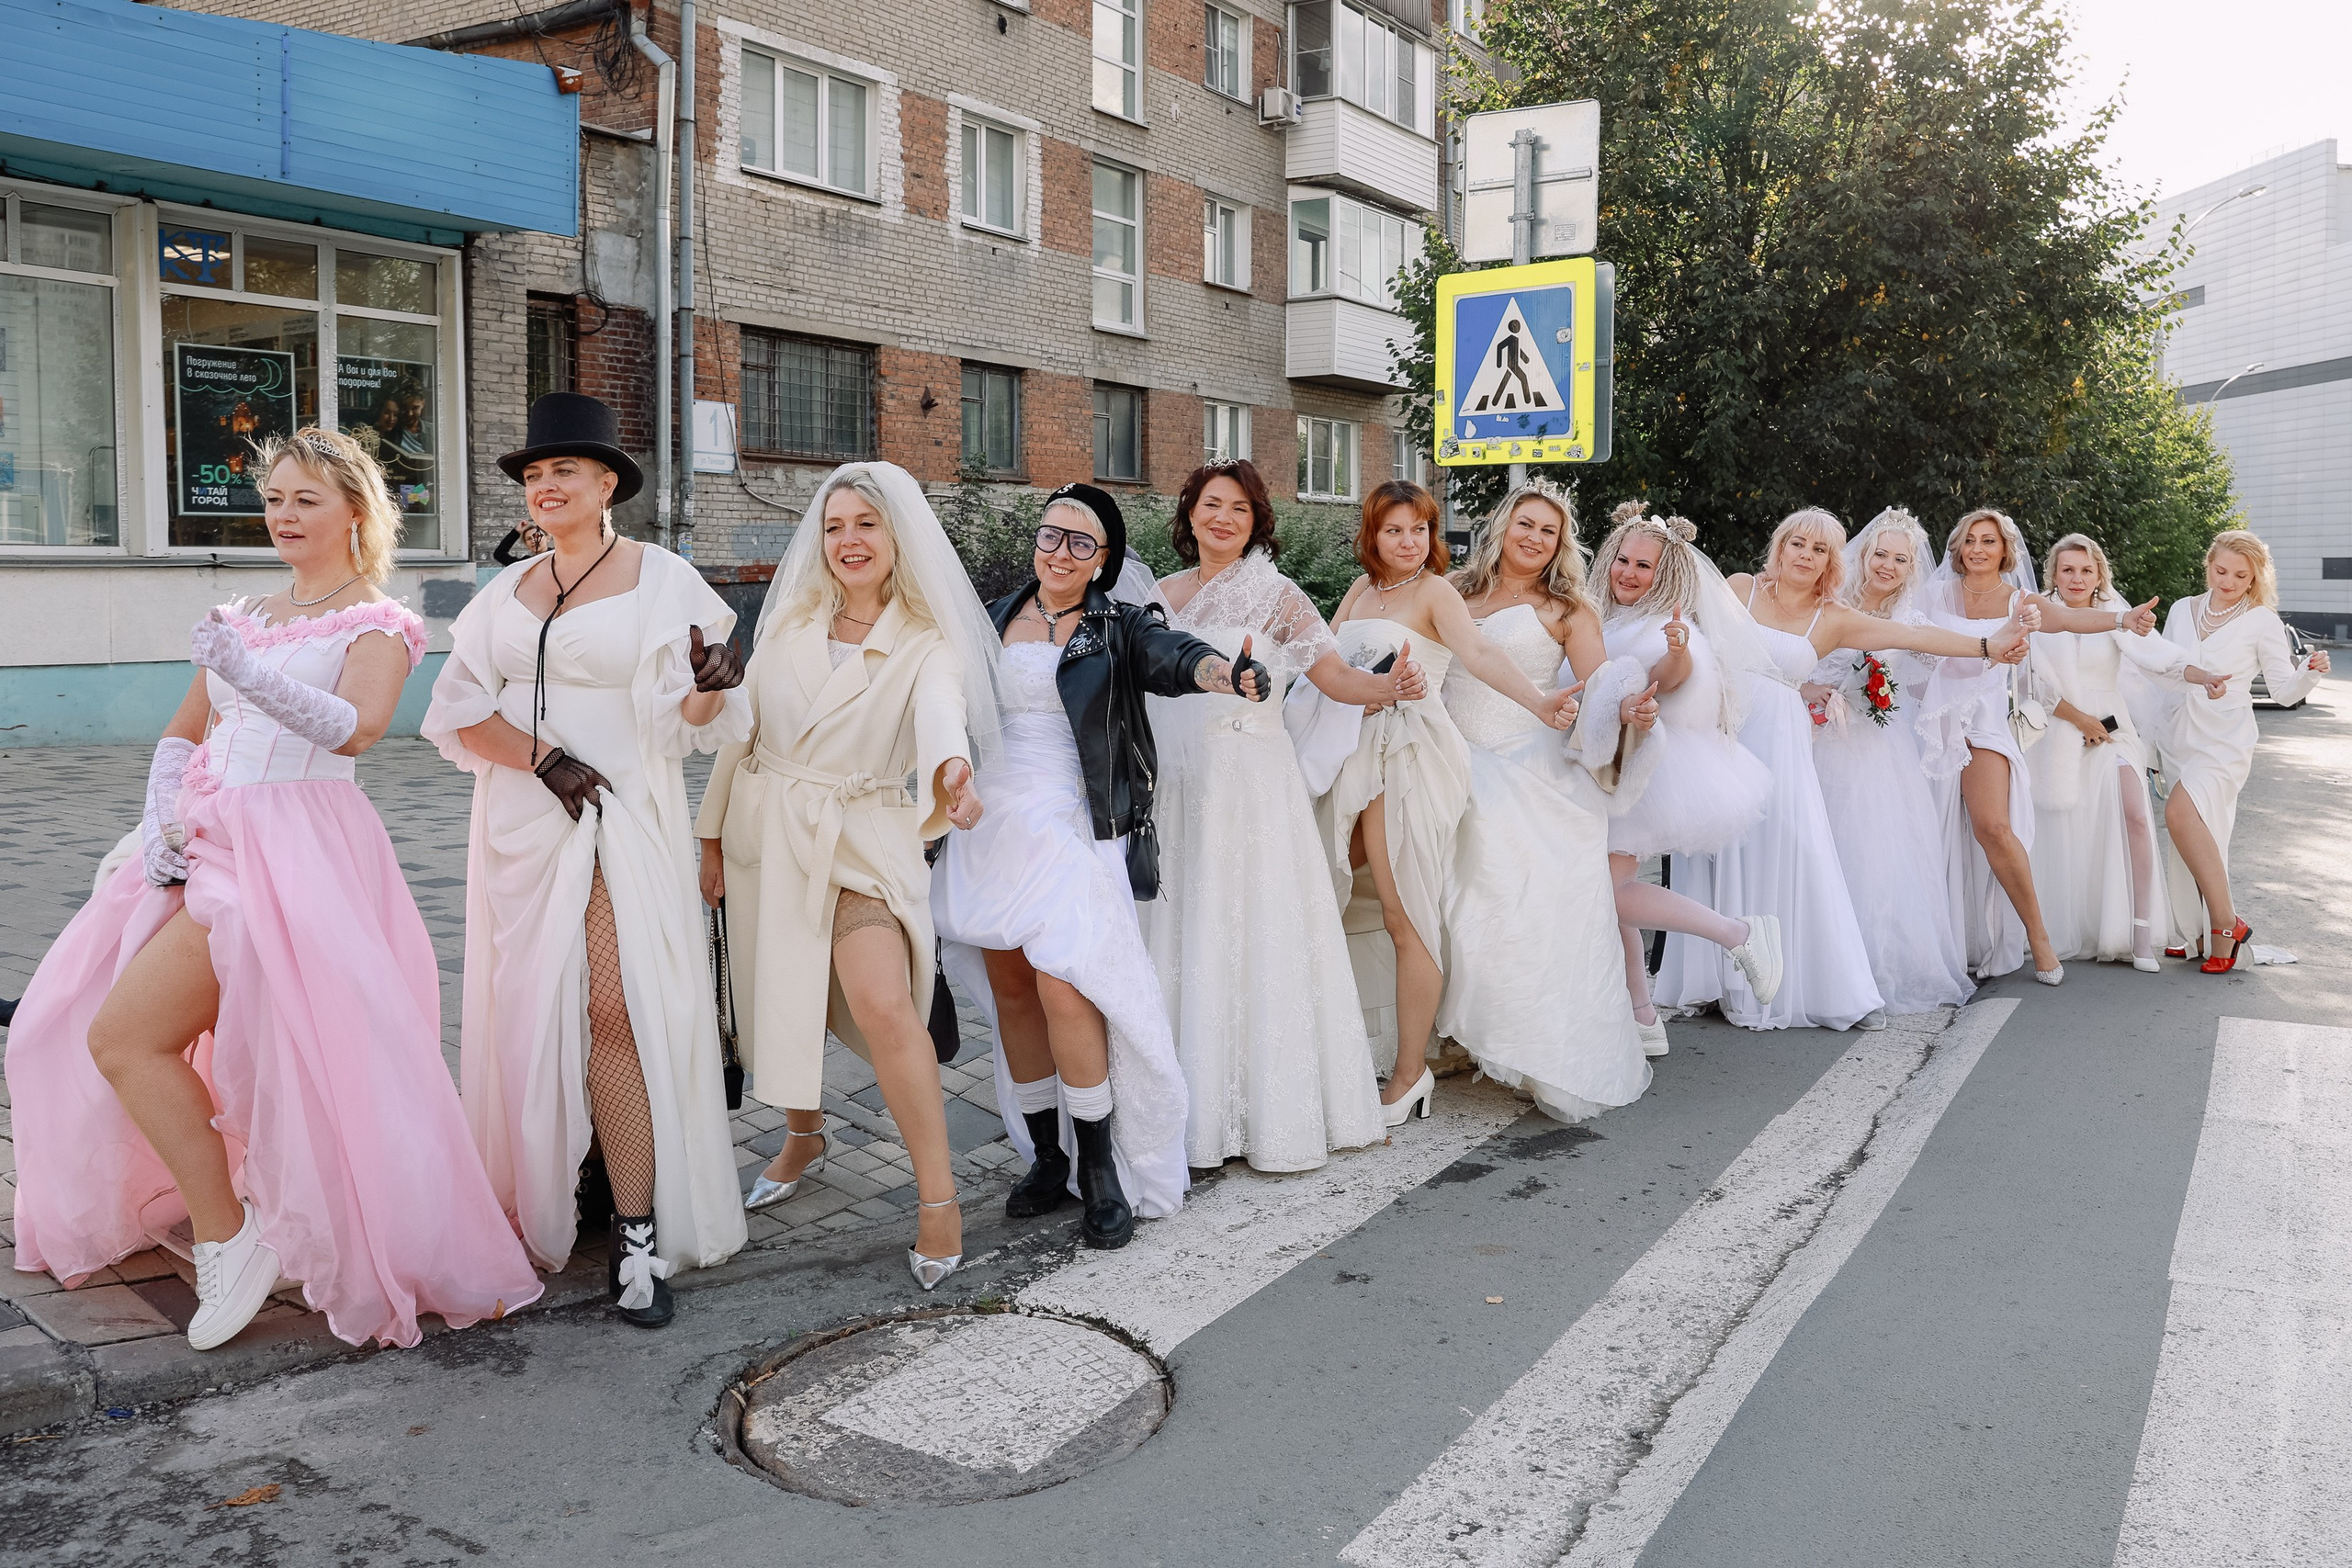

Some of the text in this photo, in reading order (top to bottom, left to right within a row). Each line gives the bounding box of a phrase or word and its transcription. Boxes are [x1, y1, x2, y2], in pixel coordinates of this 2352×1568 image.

[187, 355, 237, 369] Погружение
[195, 370, 238, 381] сказочное
[240, 374, 257, 383] лето
[338, 363, 345, 374] А
[368, 368, 381, 378] для
[338, 378, 381, 389] подарочек!
[710, 409, 718, 446] 1
[191, 486, 228, 496] ЧИТАЙ
[192, 496, 229, 506] ГОРОД
